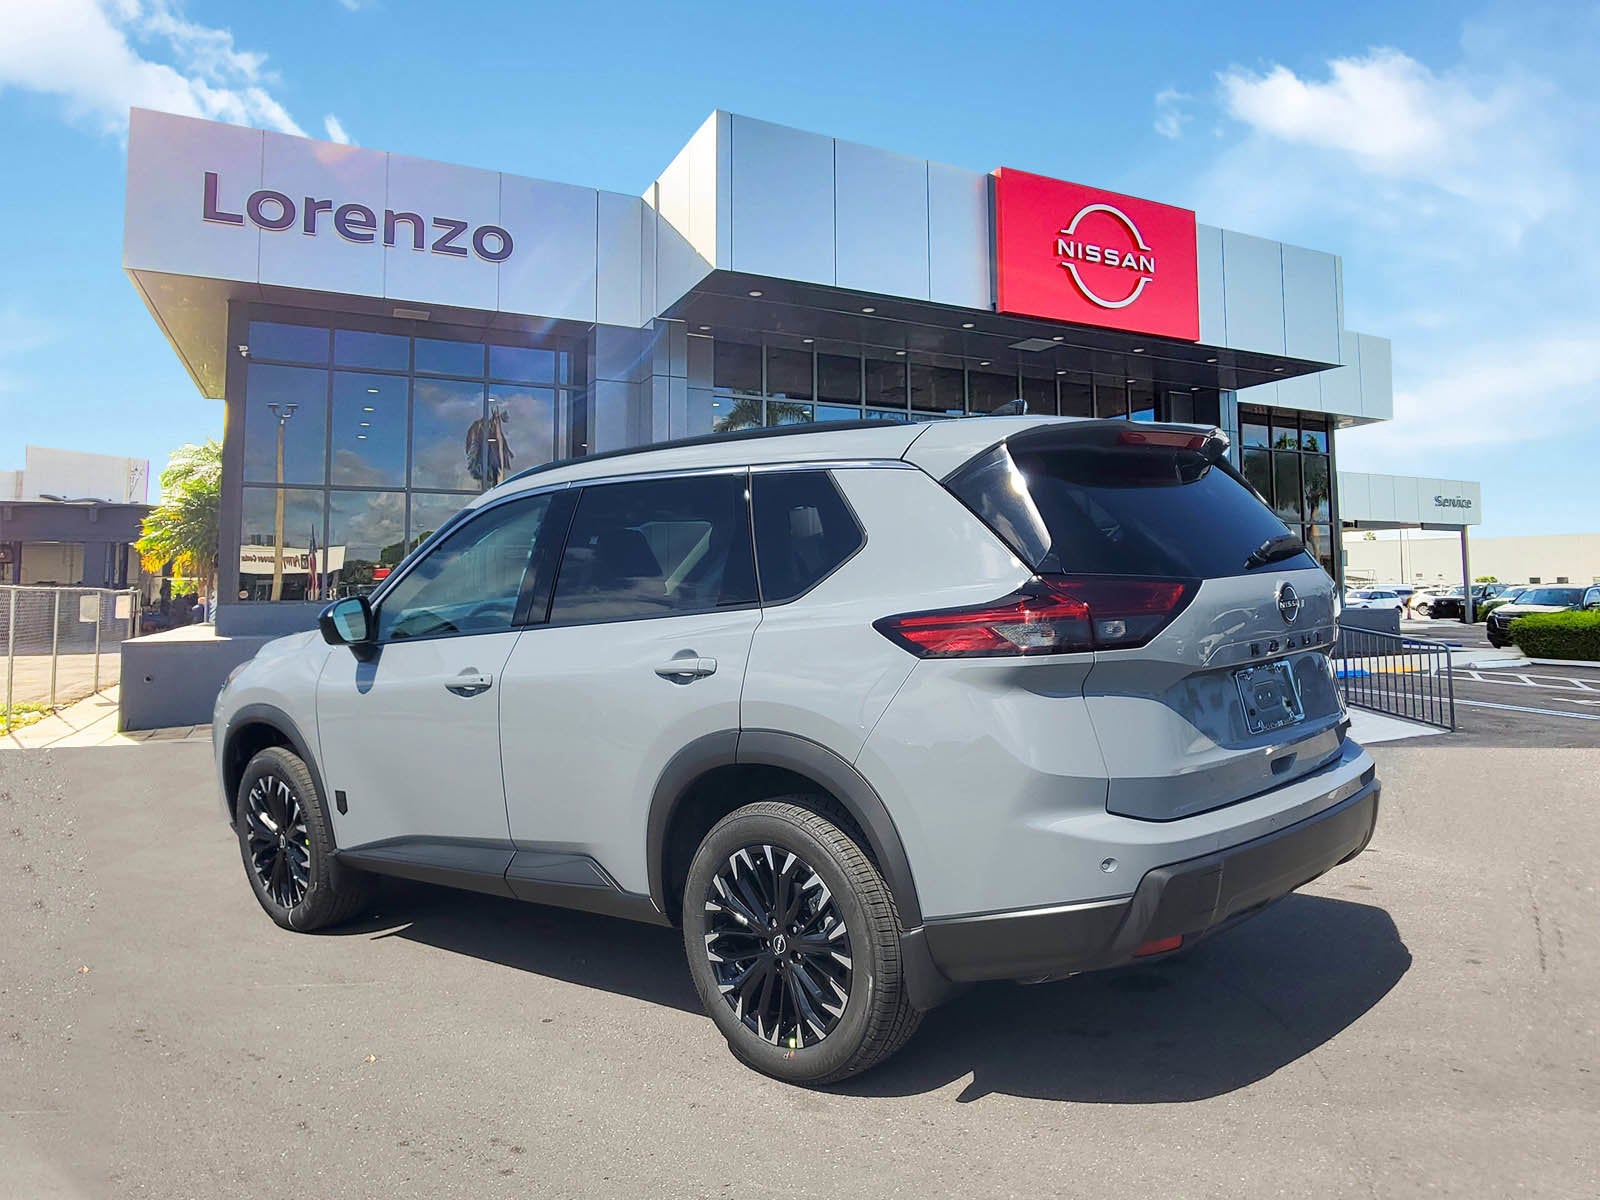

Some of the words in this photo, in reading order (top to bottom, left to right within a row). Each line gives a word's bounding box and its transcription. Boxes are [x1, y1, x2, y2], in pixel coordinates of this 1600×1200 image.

[203, 171, 514, 262] Lorenzo
[1058, 238, 1155, 273] NISSAN
[1434, 495, 1472, 508] Service
